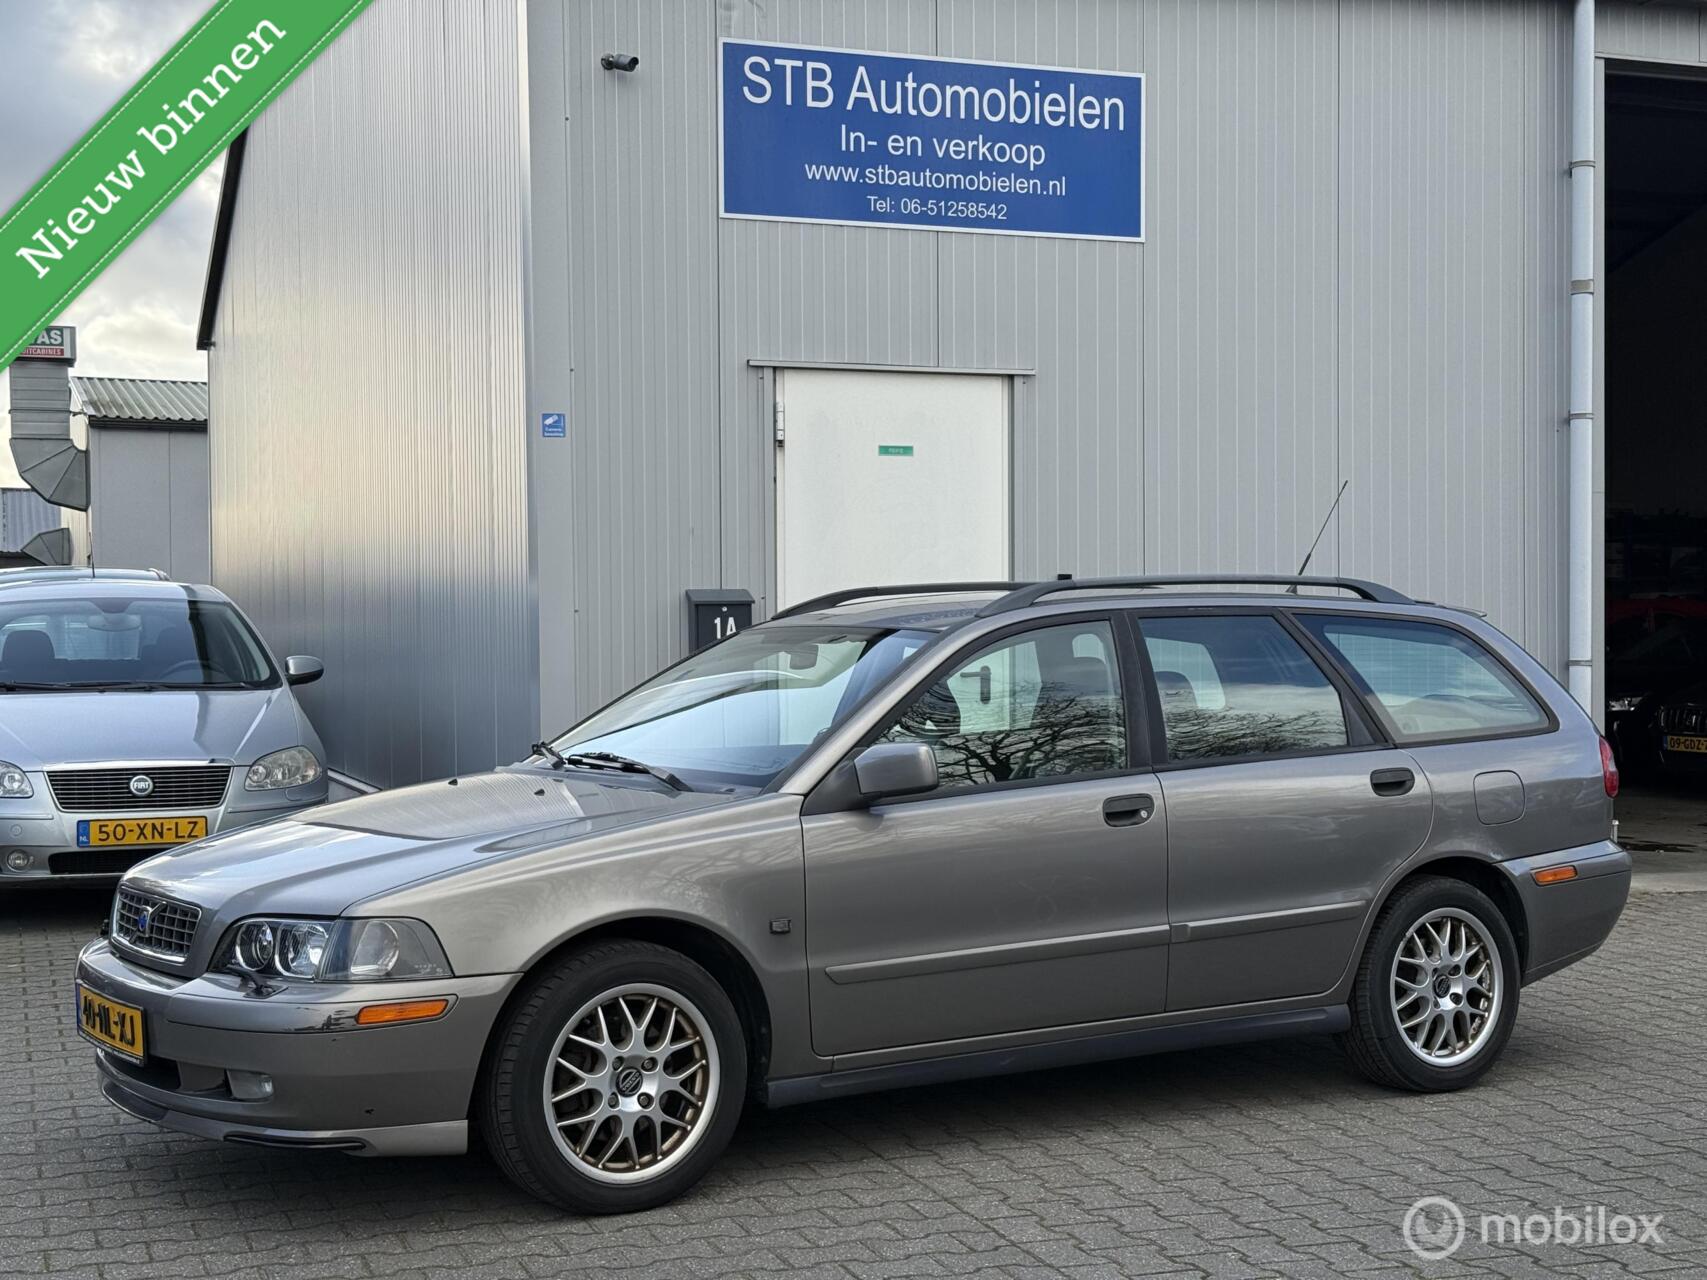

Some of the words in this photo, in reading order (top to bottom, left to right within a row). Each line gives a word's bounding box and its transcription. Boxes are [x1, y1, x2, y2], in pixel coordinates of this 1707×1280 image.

[742, 55, 835, 108] STB
[846, 65, 1126, 131] Automobielen
[840, 124, 878, 152] In-
[887, 133, 923, 157] en
[932, 135, 1046, 171] verkoop
[804, 163, 1067, 197] www.stbautomobielen.nl
[866, 196, 896, 213] Tel:
[900, 198, 1008, 220] 06-51258542
[32, 329, 62, 345] AS
[714, 616, 737, 639] 1A
[133, 781, 149, 789] FIAT
[98, 820, 199, 842] 50-XN-LZ
